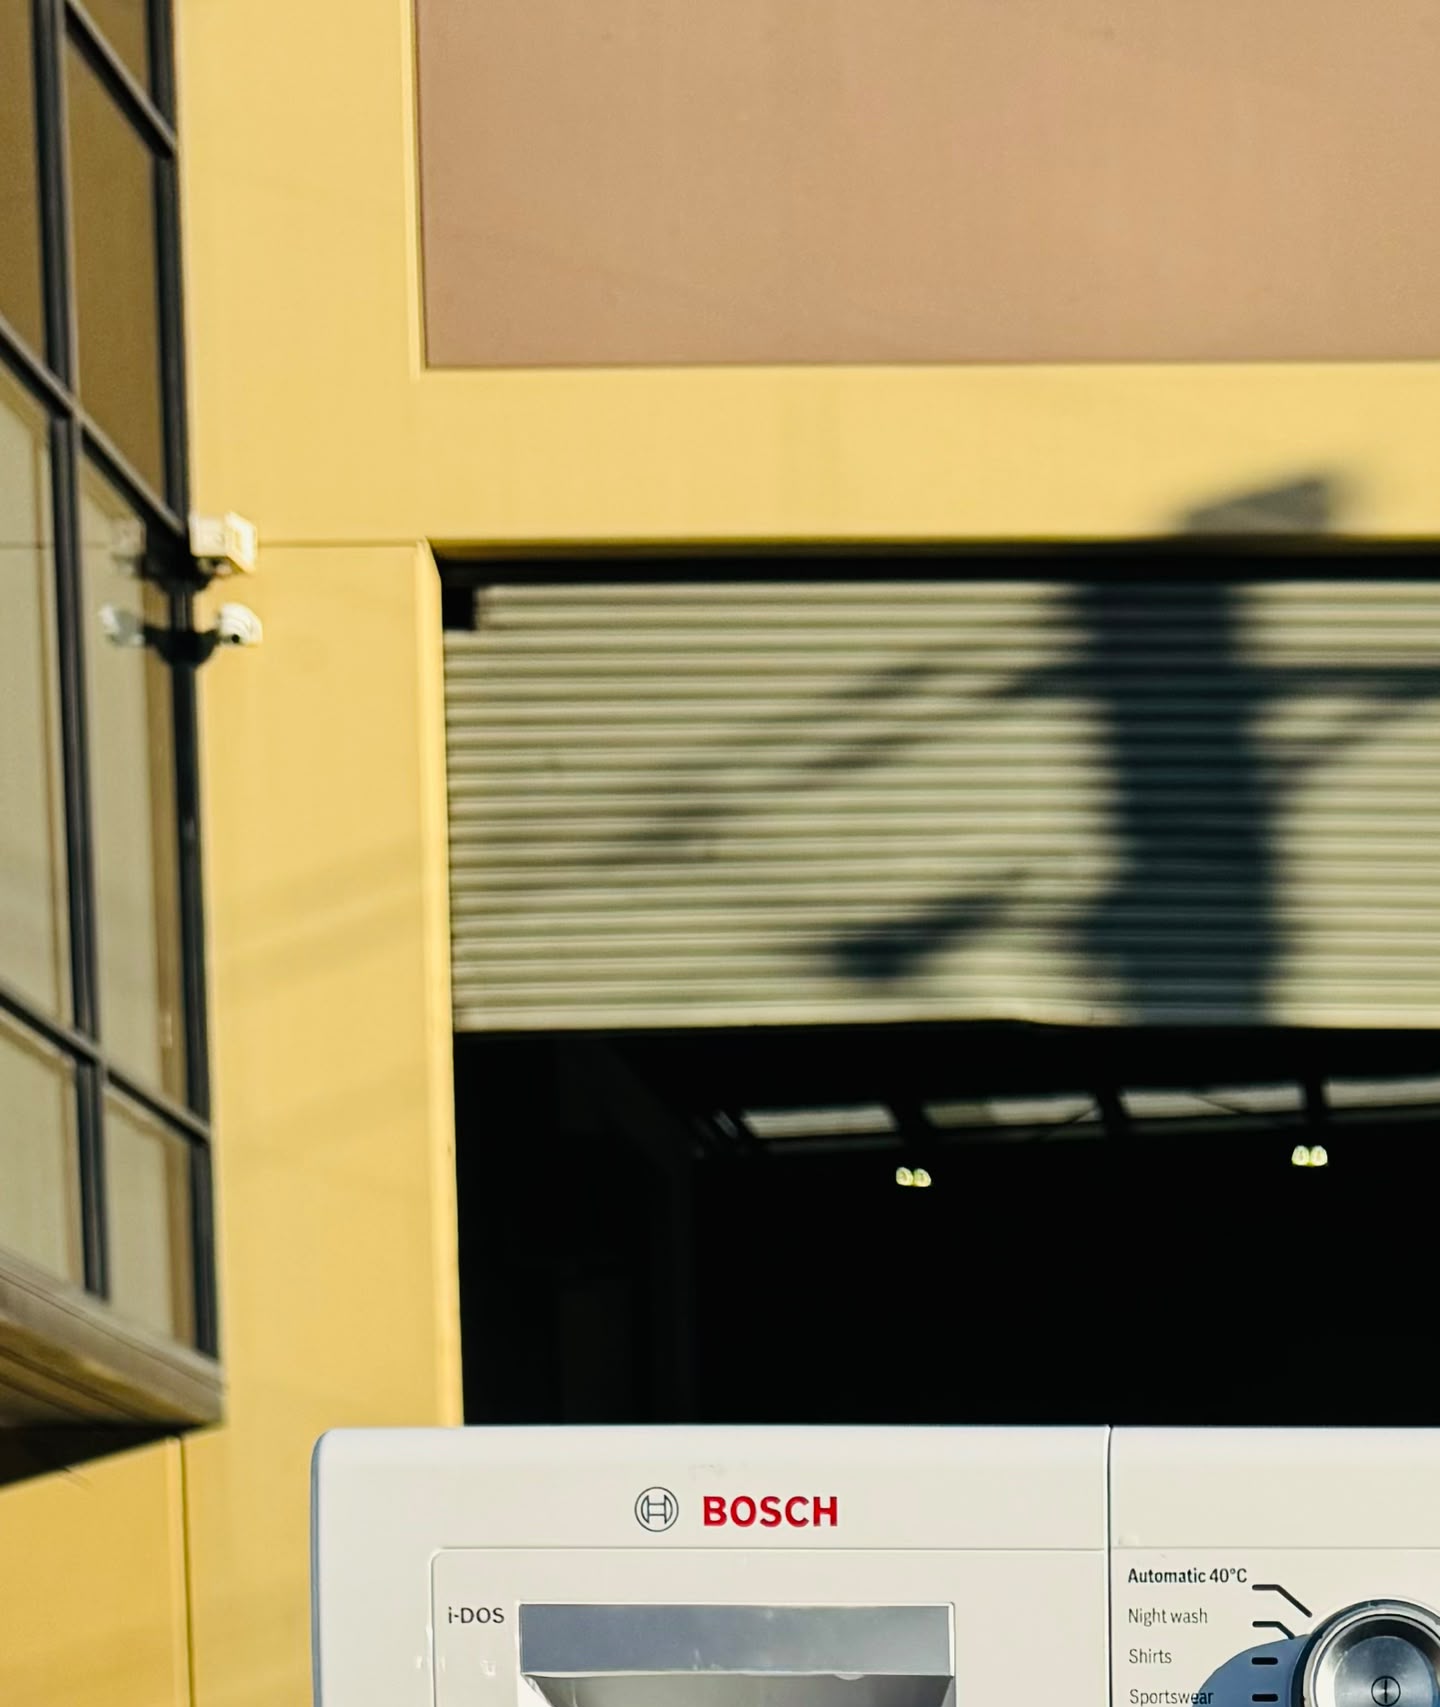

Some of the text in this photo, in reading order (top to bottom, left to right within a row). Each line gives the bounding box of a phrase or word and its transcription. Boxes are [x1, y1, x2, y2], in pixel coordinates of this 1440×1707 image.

[702, 1496, 838, 1528] BOSCH
[1128, 1568, 1247, 1584] Automatic 40°C
[448, 1606, 504, 1625] i-DOS
[1128, 1609, 1208, 1626] Night wash
[1129, 1649, 1172, 1664] Shirts
[1130, 1689, 1213, 1707] Sportswear
